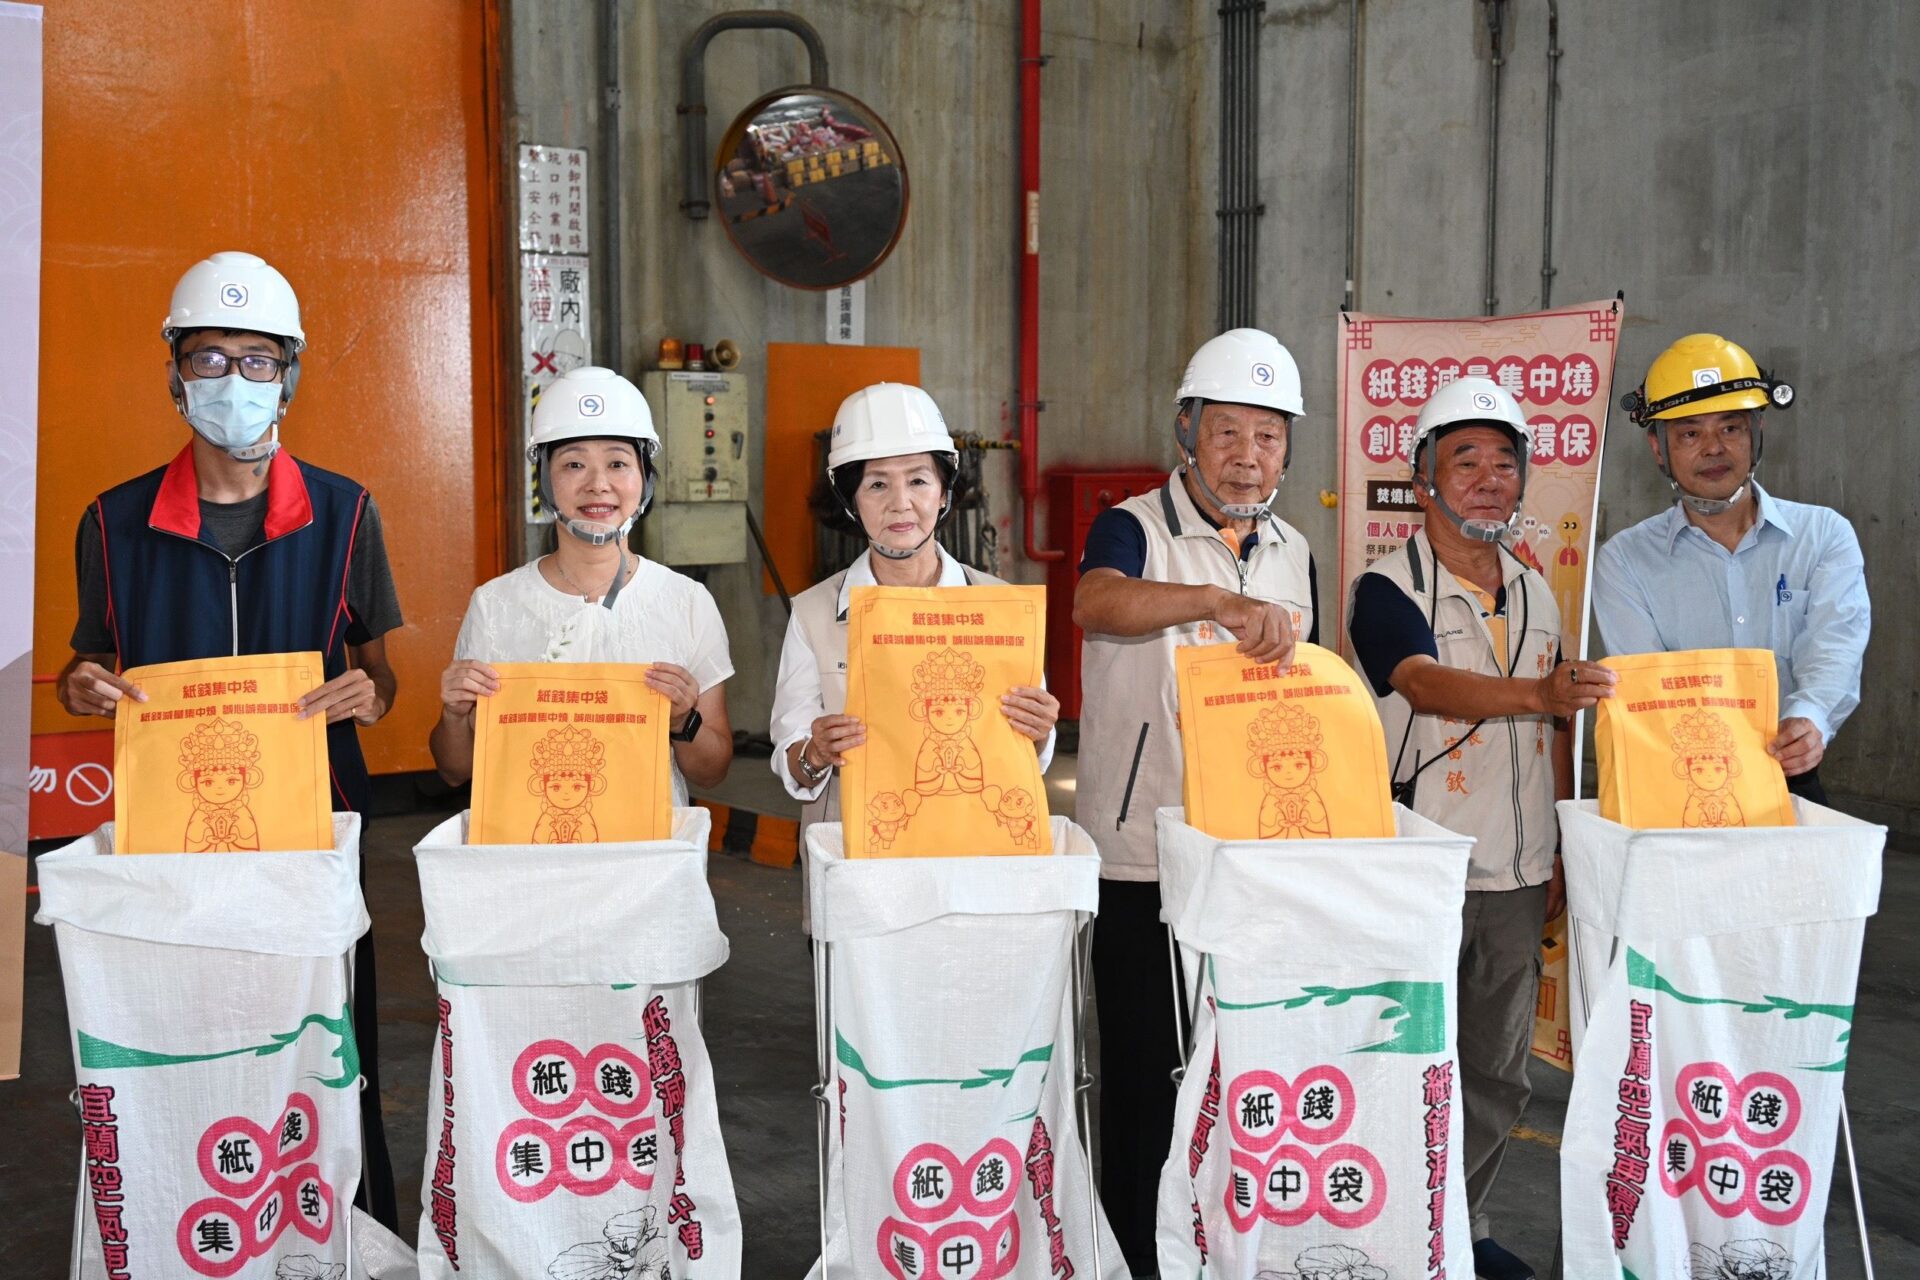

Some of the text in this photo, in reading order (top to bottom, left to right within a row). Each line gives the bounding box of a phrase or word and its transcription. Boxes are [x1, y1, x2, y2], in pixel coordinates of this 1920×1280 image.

[560, 268, 580, 323] 廠內
[911, 612, 985, 626] 紙錢集中袋
[182, 679, 258, 699] 紙錢集中袋
[536, 689, 609, 705] 紙錢集中袋
[1660, 674, 1724, 690] 紙錢集中袋
[532, 1061, 633, 1099] 紙錢
[1241, 1086, 1333, 1129] 紙錢
[1691, 1081, 1781, 1128] 紙錢
[911, 1158, 1004, 1200] 紙錢
[1666, 1139, 1794, 1205] 集中袋
